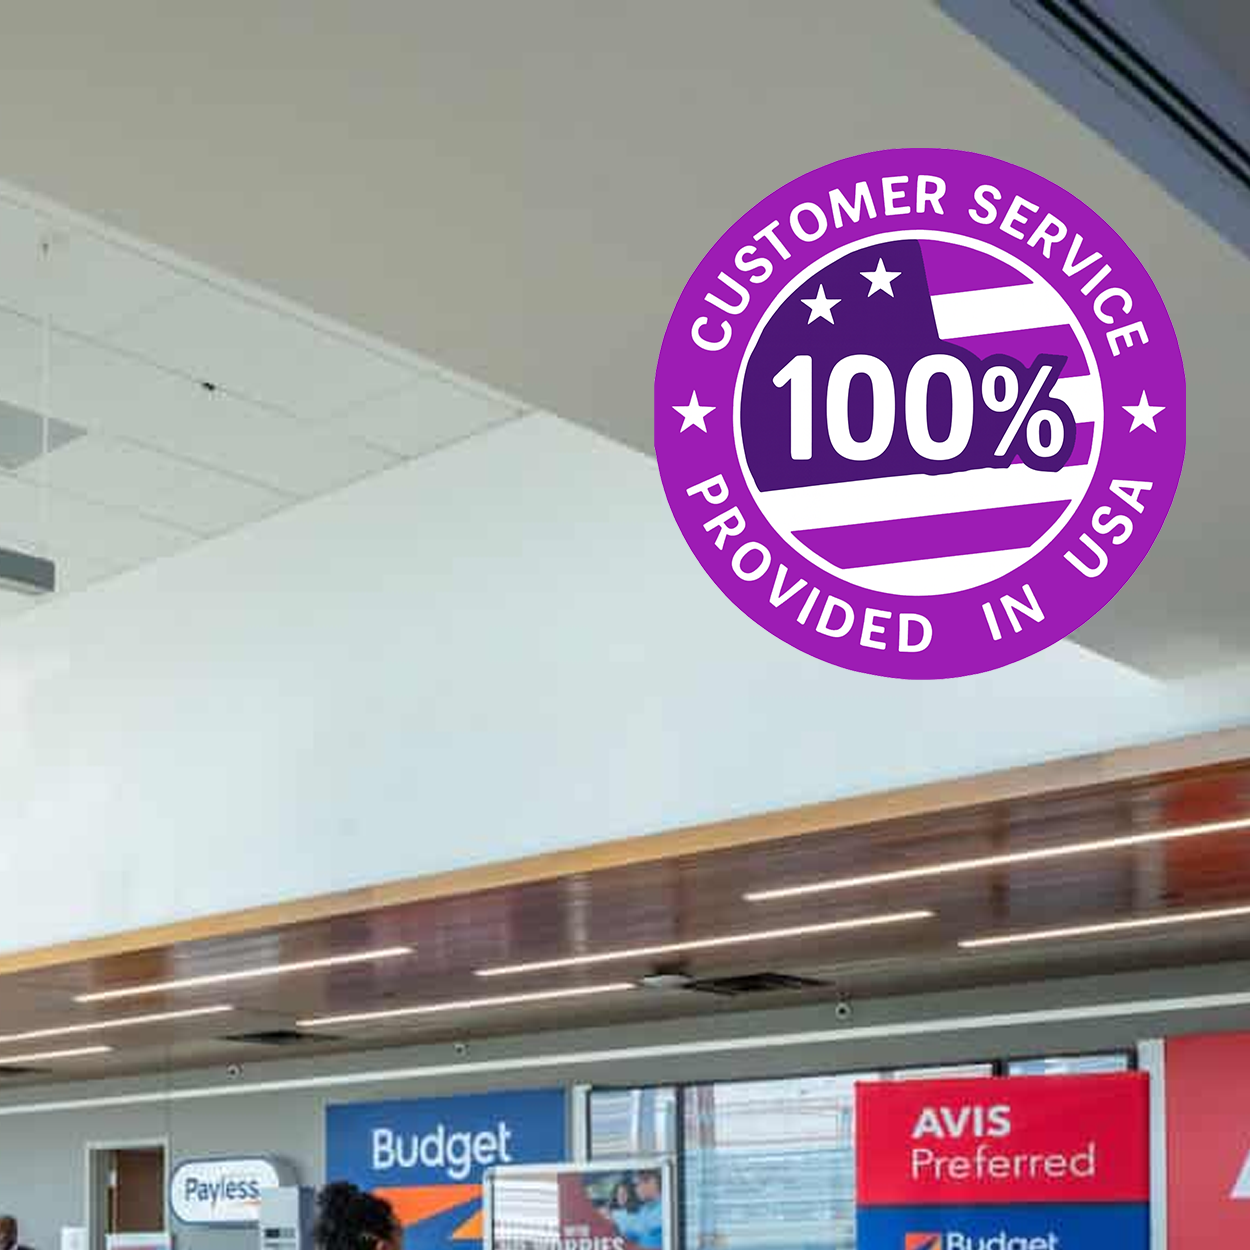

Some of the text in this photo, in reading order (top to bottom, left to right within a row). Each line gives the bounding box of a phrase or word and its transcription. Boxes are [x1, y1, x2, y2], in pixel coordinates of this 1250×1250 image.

[911, 1104, 1011, 1139] AVIS
[372, 1121, 512, 1180] Budget
[911, 1140, 1095, 1180] Preferred
[185, 1177, 260, 1208] Payless
